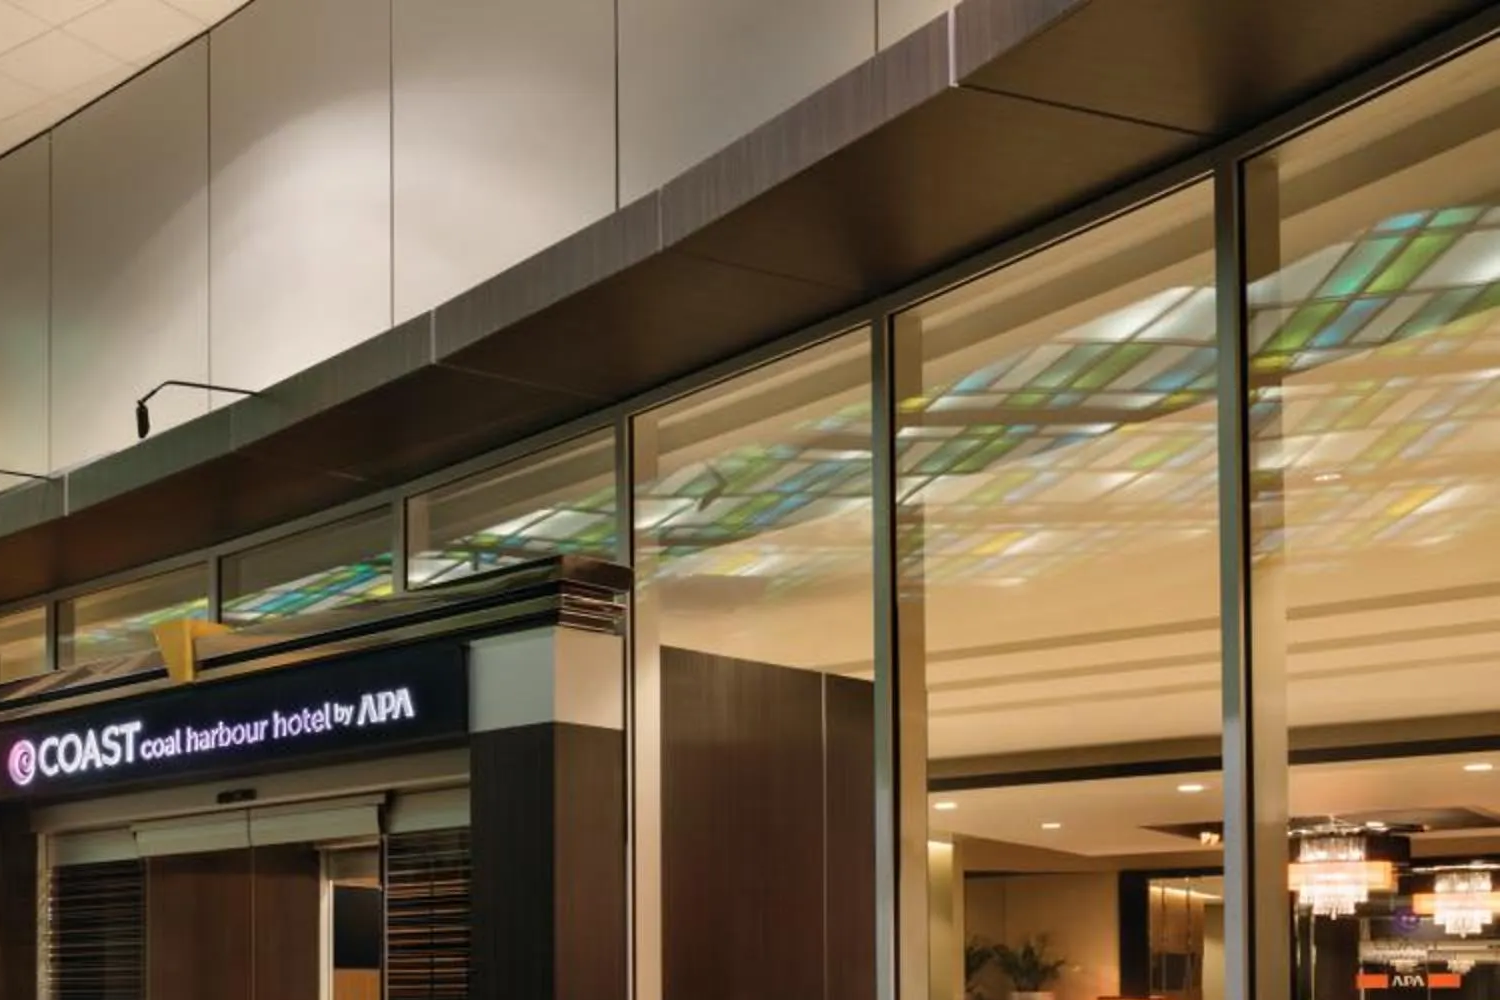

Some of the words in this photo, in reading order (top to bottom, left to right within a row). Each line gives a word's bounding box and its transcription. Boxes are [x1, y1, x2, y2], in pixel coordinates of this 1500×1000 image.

[38, 720, 142, 777] COAST
[140, 728, 181, 760] coal
[185, 711, 268, 753] harbour
[272, 702, 332, 739] hotel
[333, 702, 354, 726] by
[357, 687, 415, 726] APA
[1391, 975, 1425, 987] APA
